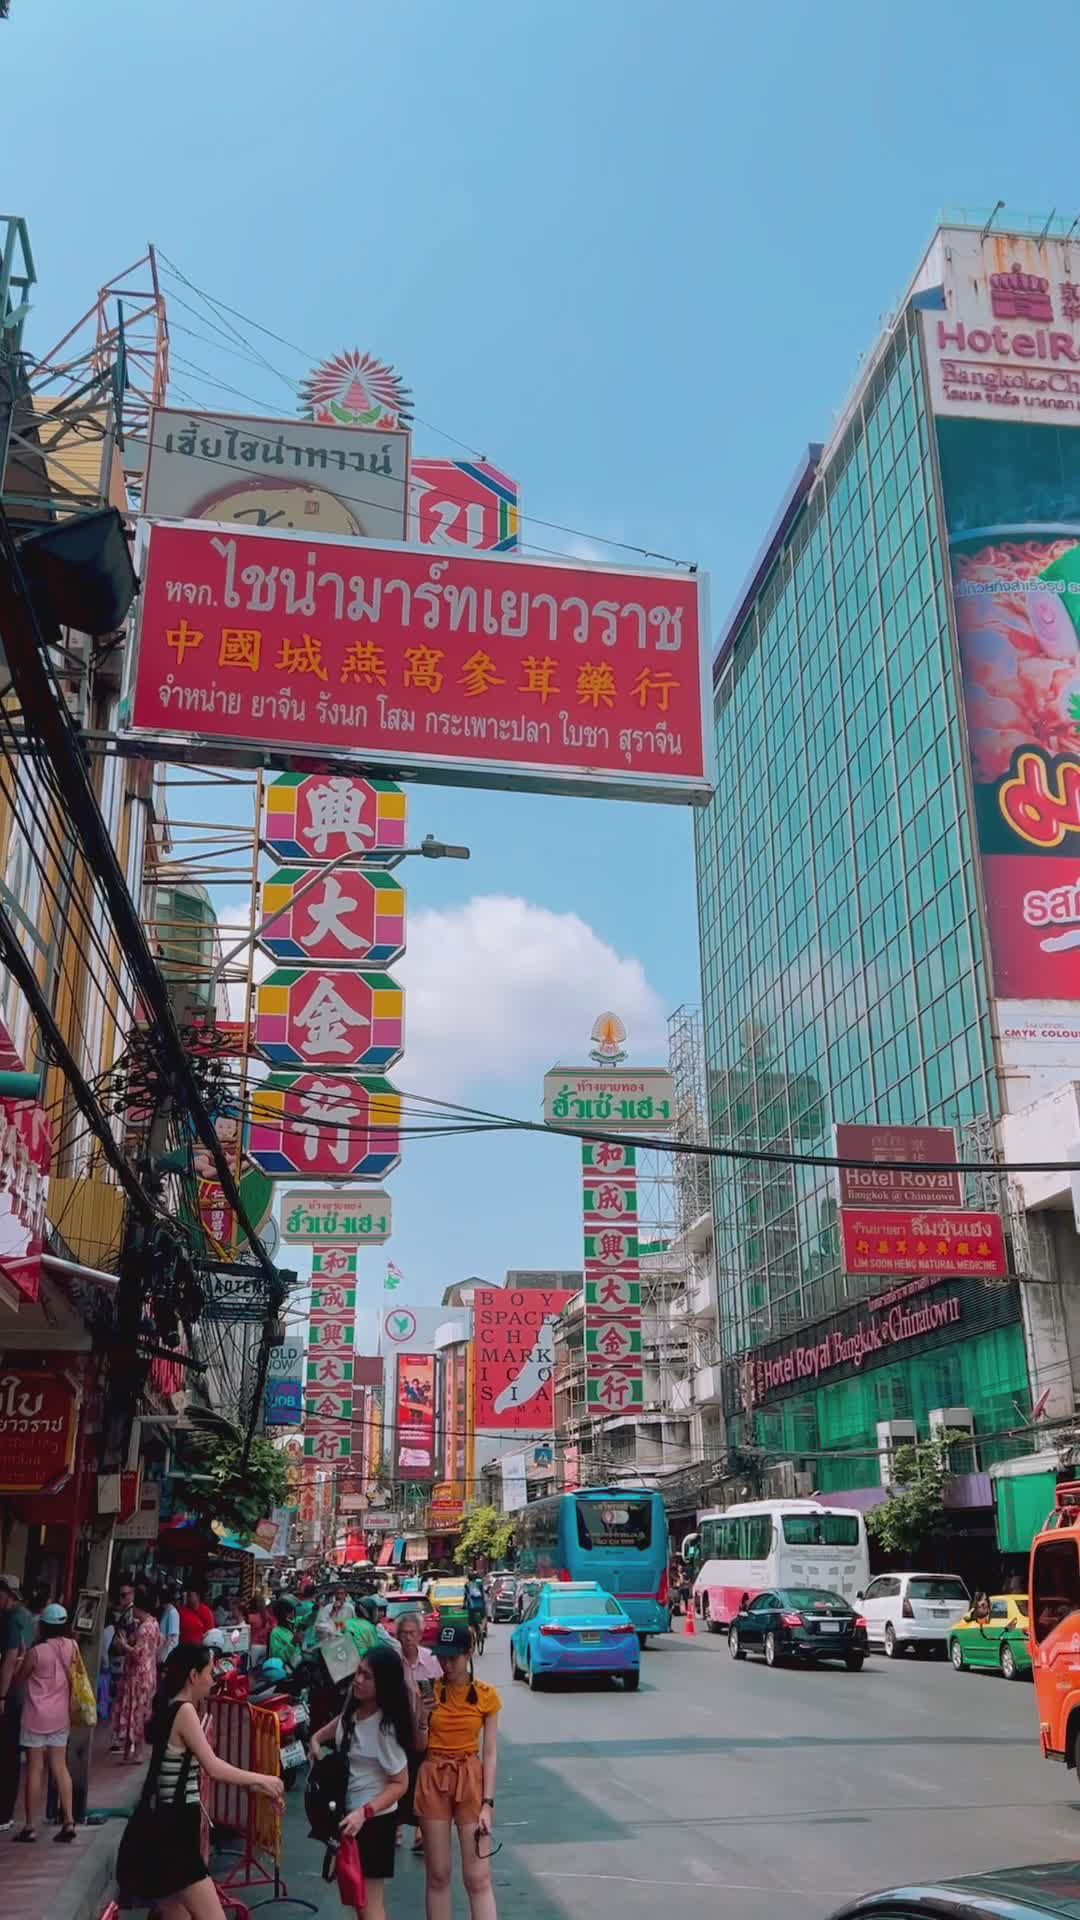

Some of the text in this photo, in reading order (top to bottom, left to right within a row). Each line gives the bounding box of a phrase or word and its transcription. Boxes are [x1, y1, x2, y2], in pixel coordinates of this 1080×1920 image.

[165, 536, 684, 652] หจก. ไชน่ามาร์ทเยาวราช
[158, 673, 682, 764] จำหน่าย ยาจีน รังนก โสม กระเพาะปลา ใบชา สุราจีน
[1004, 1029, 1080, 1038] CMYK COLOU
[846, 1169, 953, 1188] Hotel Royal
[848, 1190, 889, 1201] Bangkok
[904, 1191, 955, 1202] Chinatown
[854, 1258, 998, 1271] LIM SOON HENG NATURAL MEDICINE
[481, 1291, 575, 1306] BOY
[481, 1311, 554, 1325] SPACE
[764, 1354, 794, 1388] Hotel
[796, 1336, 831, 1378] Royal
[832, 1319, 881, 1366] Bangkok
[889, 1297, 960, 1341] Chinatown
[270, 1348, 297, 1359] OLD
[481, 1349, 553, 1363] MARK
[0, 1376, 43, 1417] ใบ
